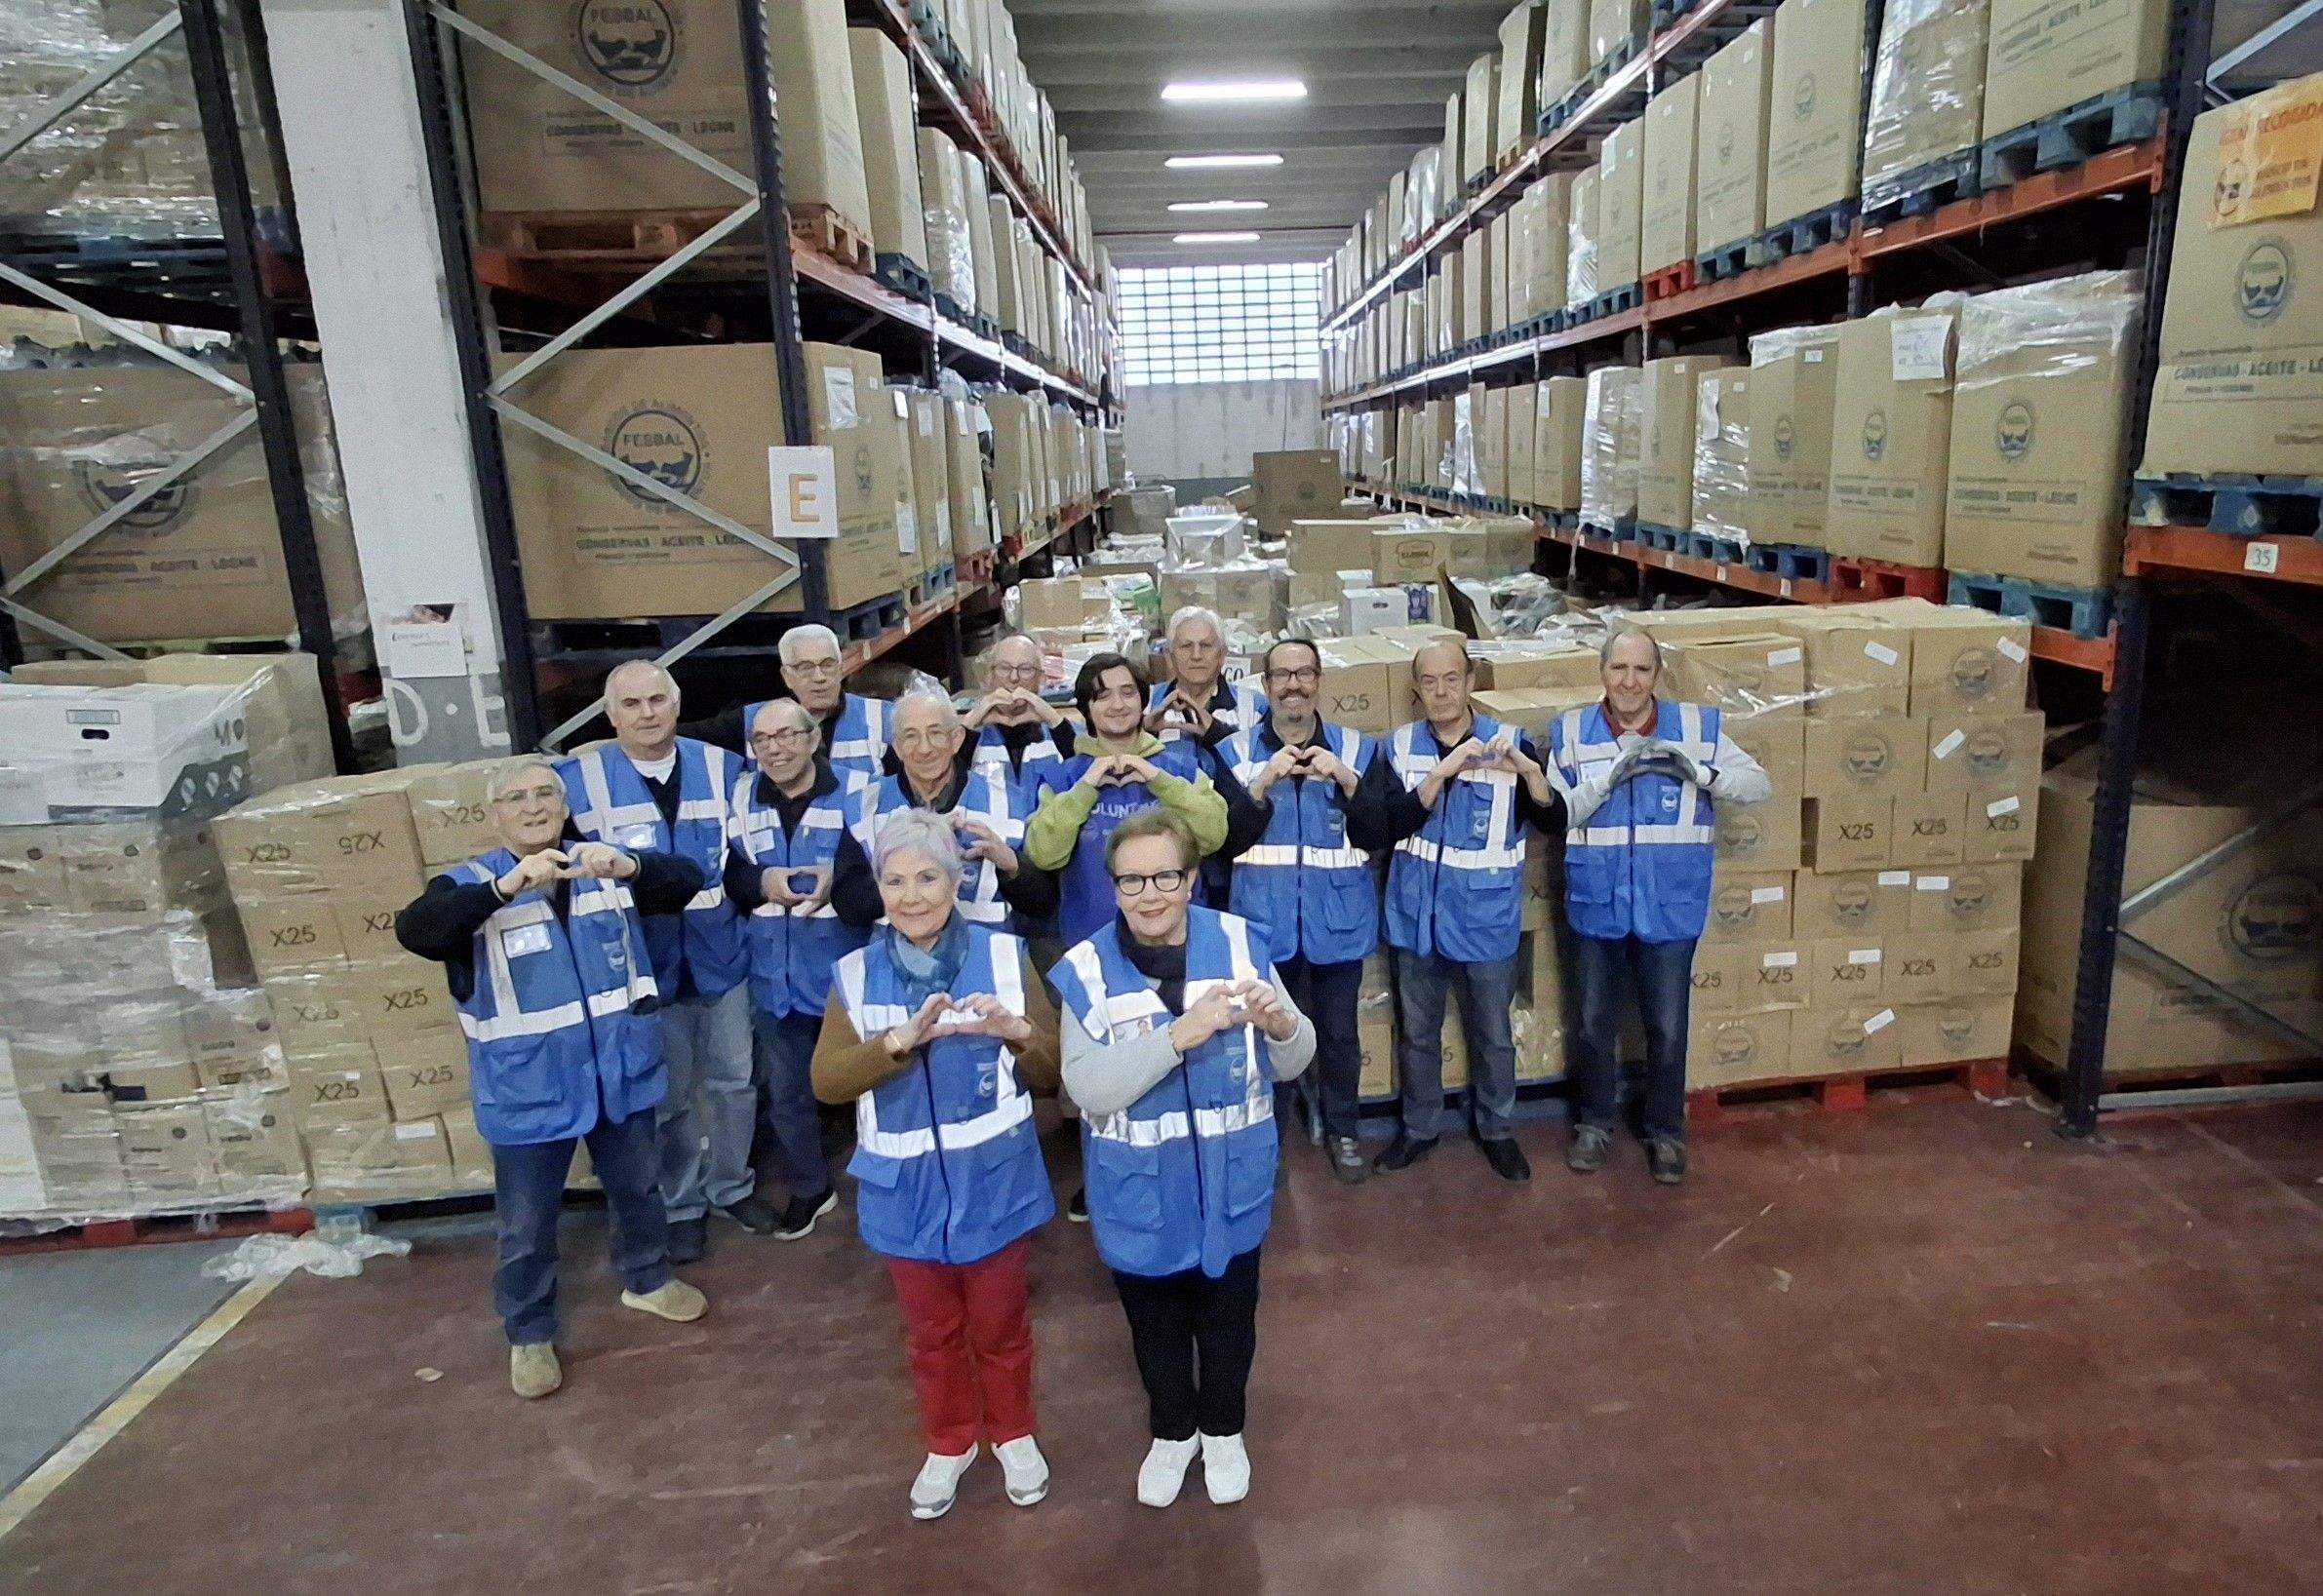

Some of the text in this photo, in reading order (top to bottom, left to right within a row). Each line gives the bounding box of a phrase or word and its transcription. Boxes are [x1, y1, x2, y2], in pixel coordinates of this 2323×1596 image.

[789, 473, 821, 523] E
[2253, 547, 2270, 566] 35
[1332, 694, 1369, 714] X25
[441, 802, 487, 828] X25
[1839, 823, 1874, 842] X25
[1910, 816, 1947, 837] X25
[246, 843, 292, 862] X25
[337, 831, 385, 855] X25
[270, 925, 316, 947] X25
[1901, 958, 1937, 976] X25
[1968, 952, 2003, 968] X25
[1757, 966, 1793, 986] X25
[1831, 963, 1867, 982] X25
[382, 988, 428, 1012] X25
[410, 1065, 454, 1089] X25
[314, 1080, 360, 1103] X25
